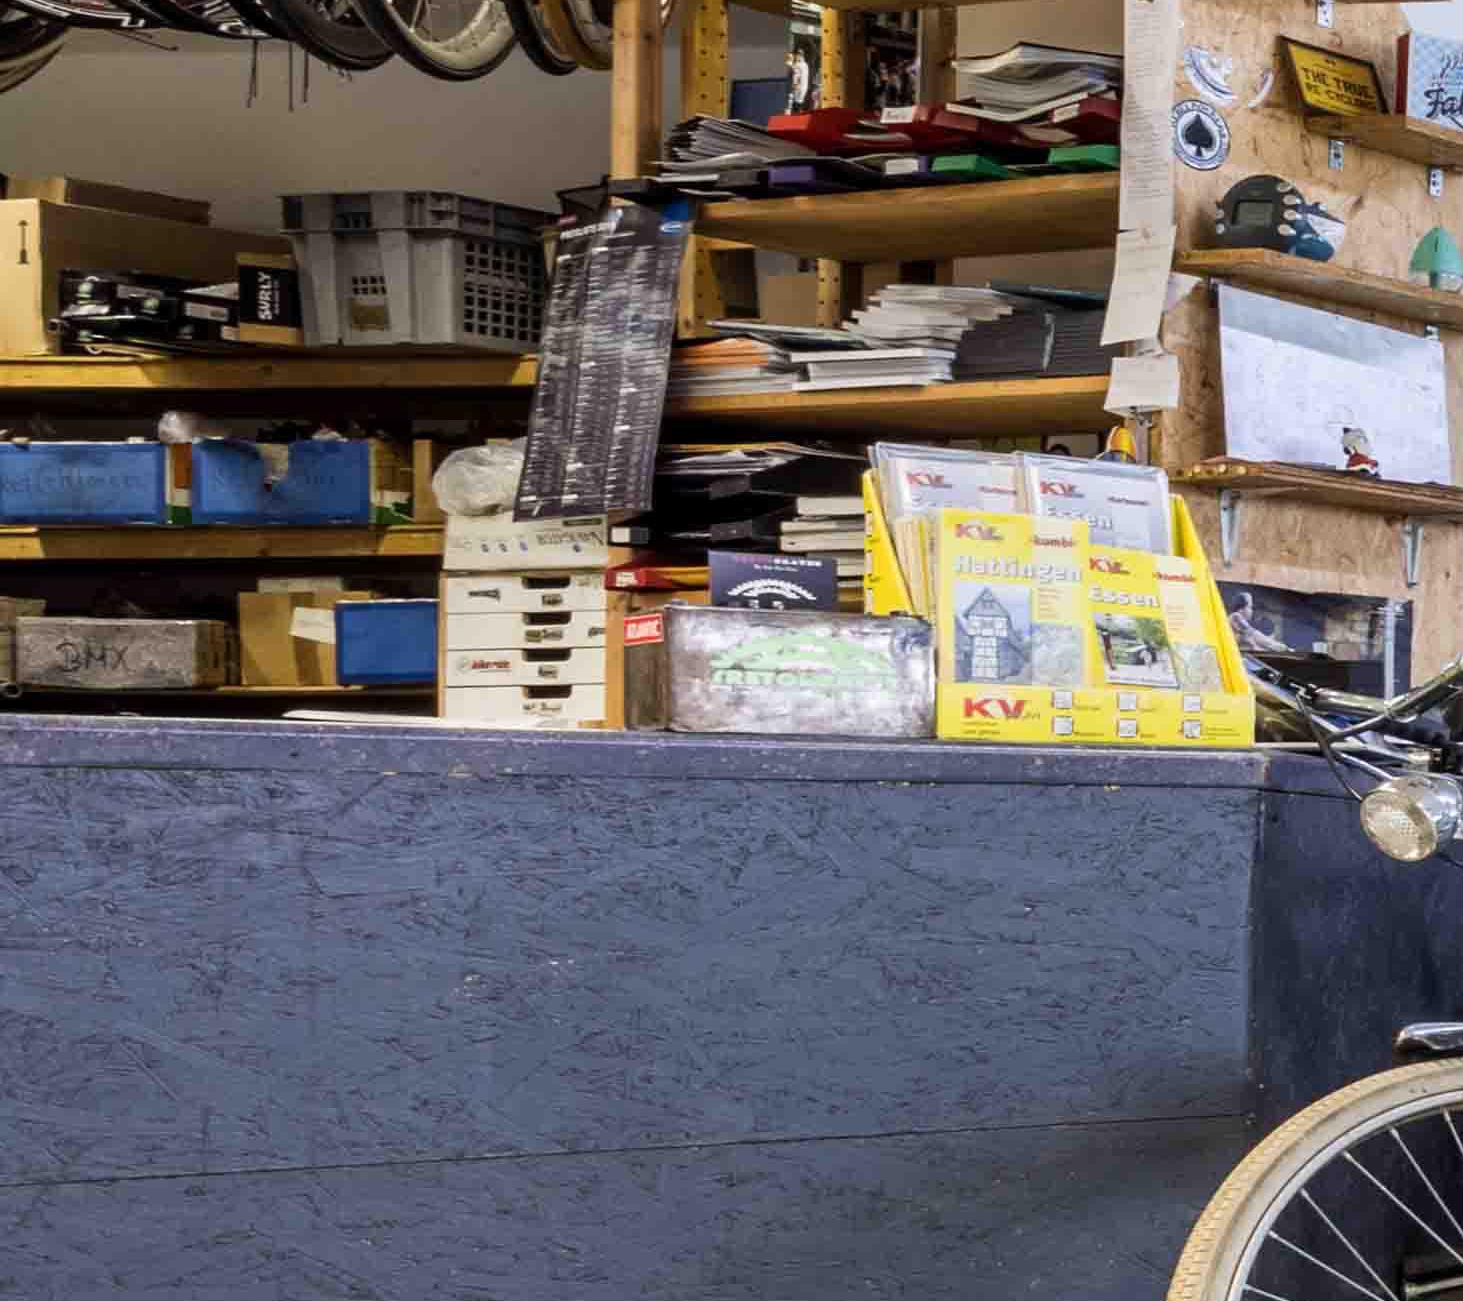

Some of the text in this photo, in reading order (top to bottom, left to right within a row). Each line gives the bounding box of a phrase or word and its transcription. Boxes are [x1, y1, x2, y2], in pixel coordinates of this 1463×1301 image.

[257, 271, 273, 321] SURLY
[953, 554, 1083, 583] Hattingen
[1089, 588, 1161, 608] Essen
[55, 642, 129, 672] BMX
